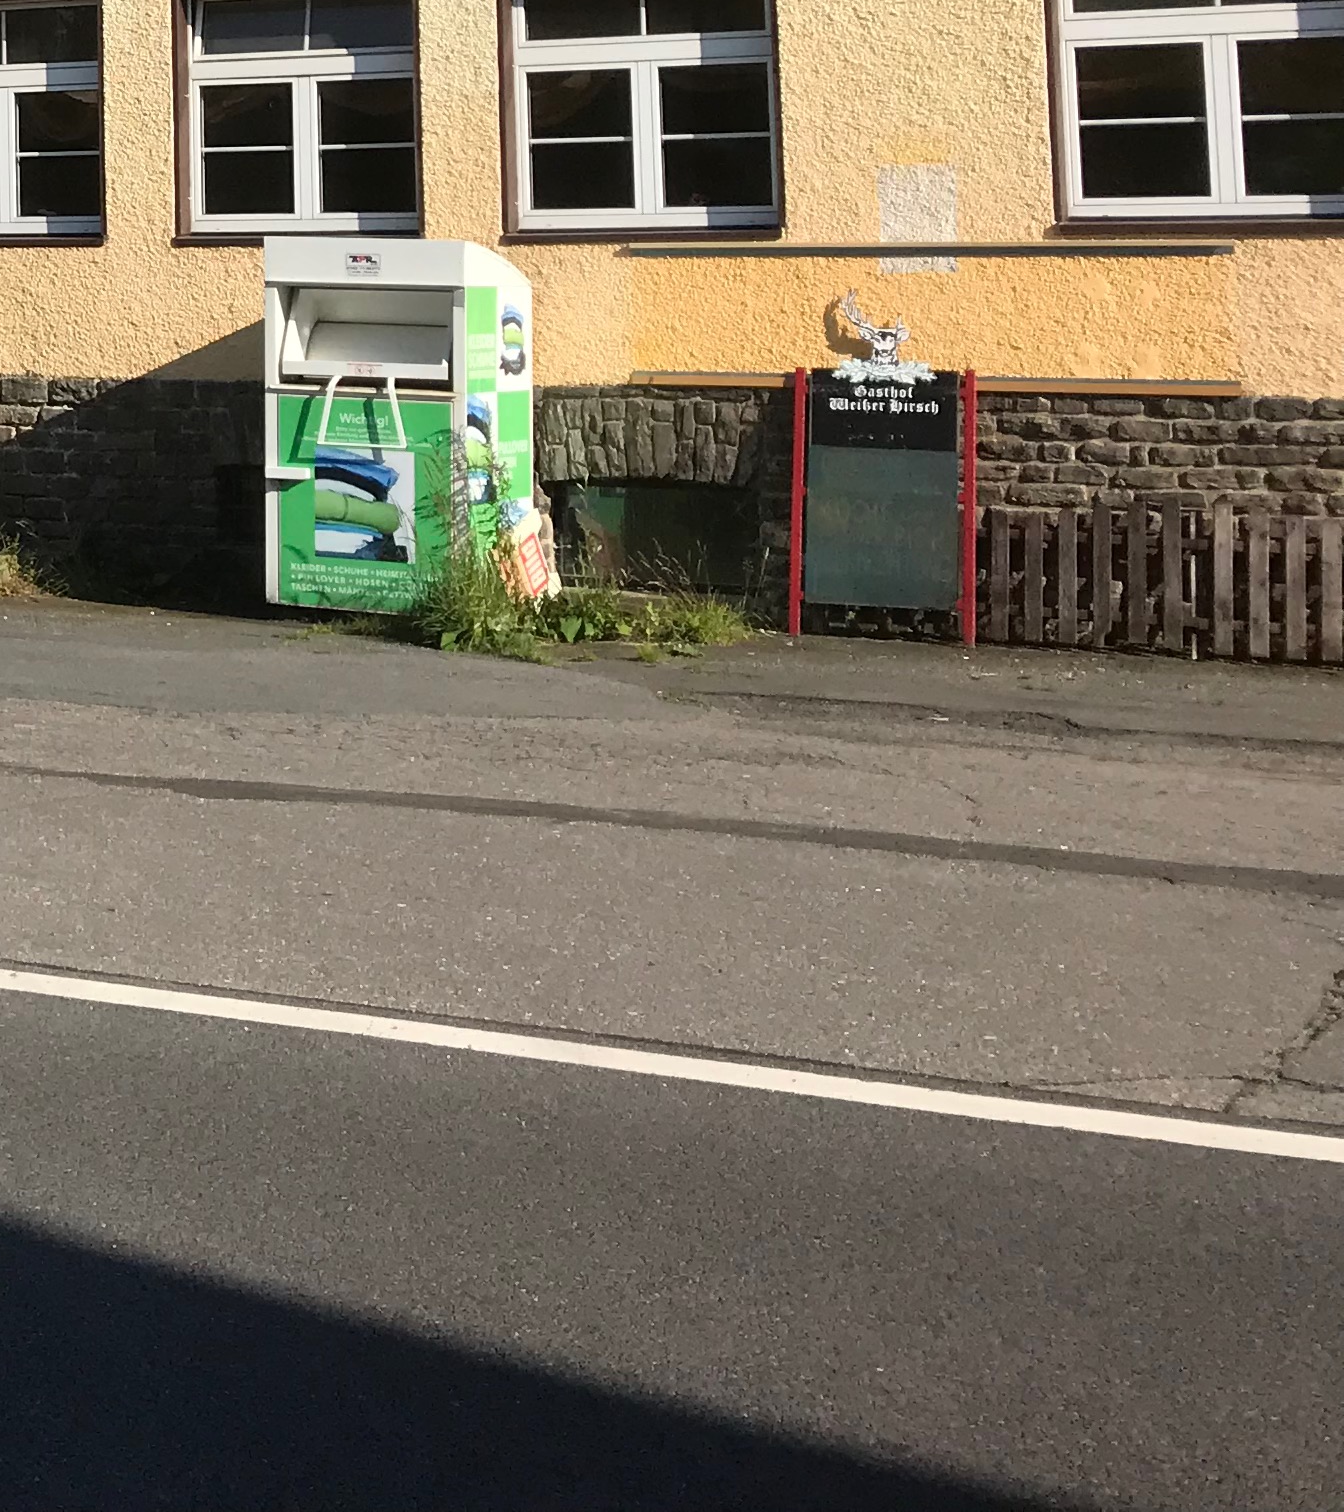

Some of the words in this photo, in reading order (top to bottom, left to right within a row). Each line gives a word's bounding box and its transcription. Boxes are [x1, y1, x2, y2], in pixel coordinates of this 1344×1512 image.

[853, 384, 914, 399] Gasthof
[829, 397, 886, 414] Weißer
[889, 399, 940, 415] Hirsch
